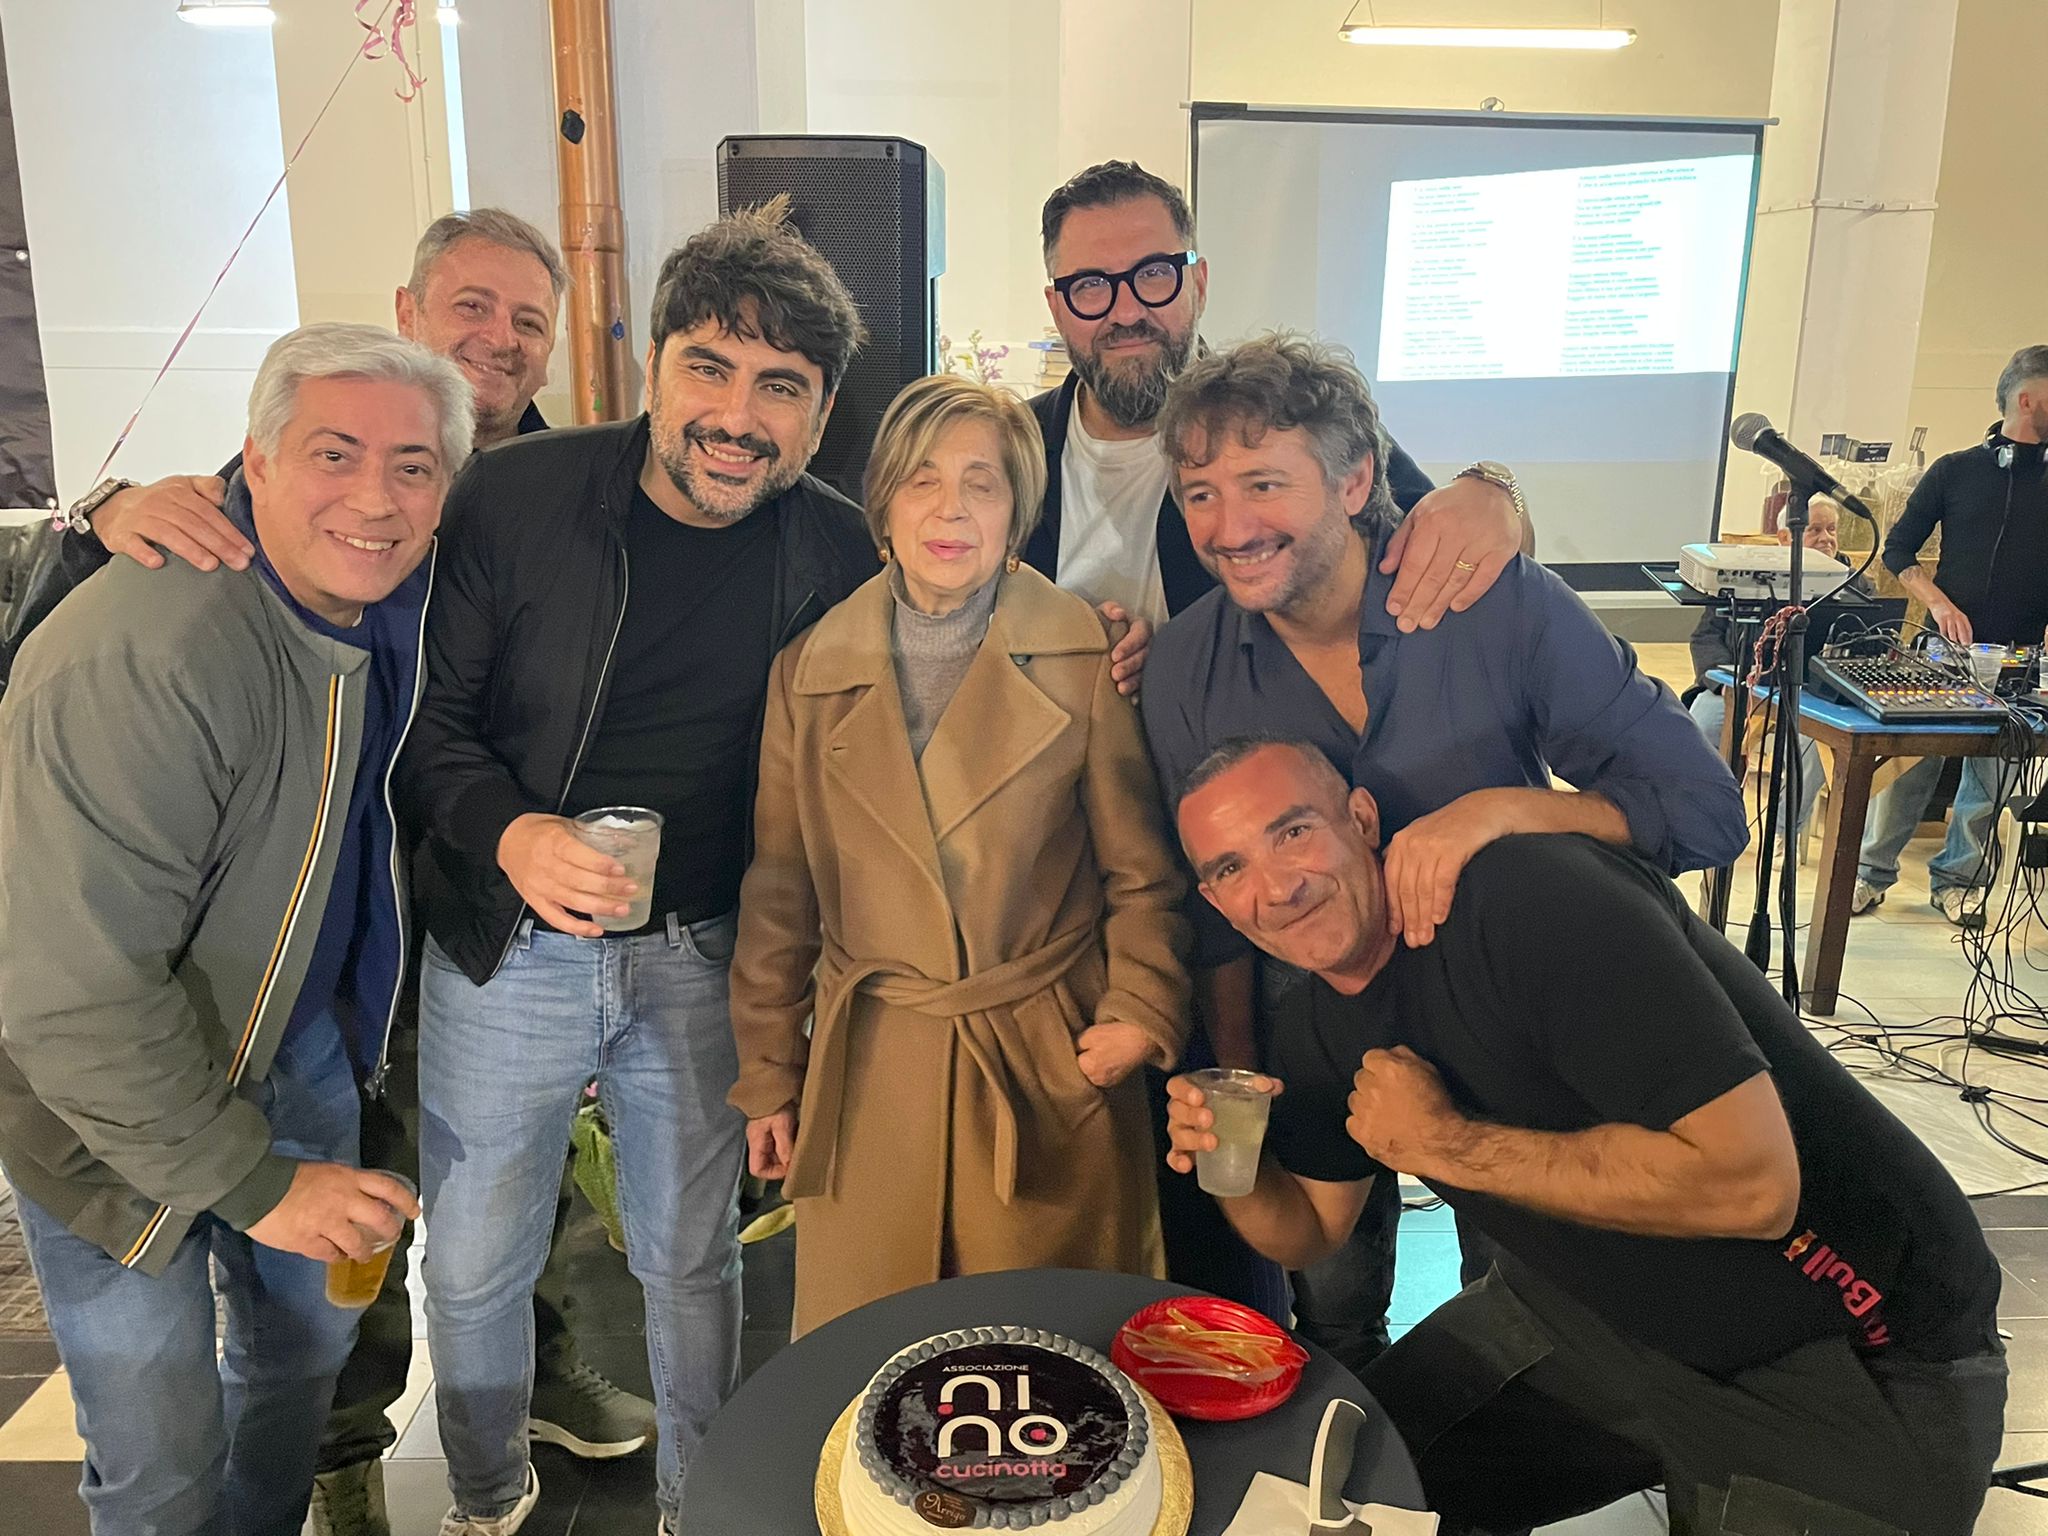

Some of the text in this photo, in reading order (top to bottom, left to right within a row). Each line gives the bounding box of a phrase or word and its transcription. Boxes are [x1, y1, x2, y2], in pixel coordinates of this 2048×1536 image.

[1802, 1245, 1882, 1319] Bull
[942, 1364, 1029, 1373] ASSOCIAZIONE
[935, 1460, 1068, 1479] cucinotta
